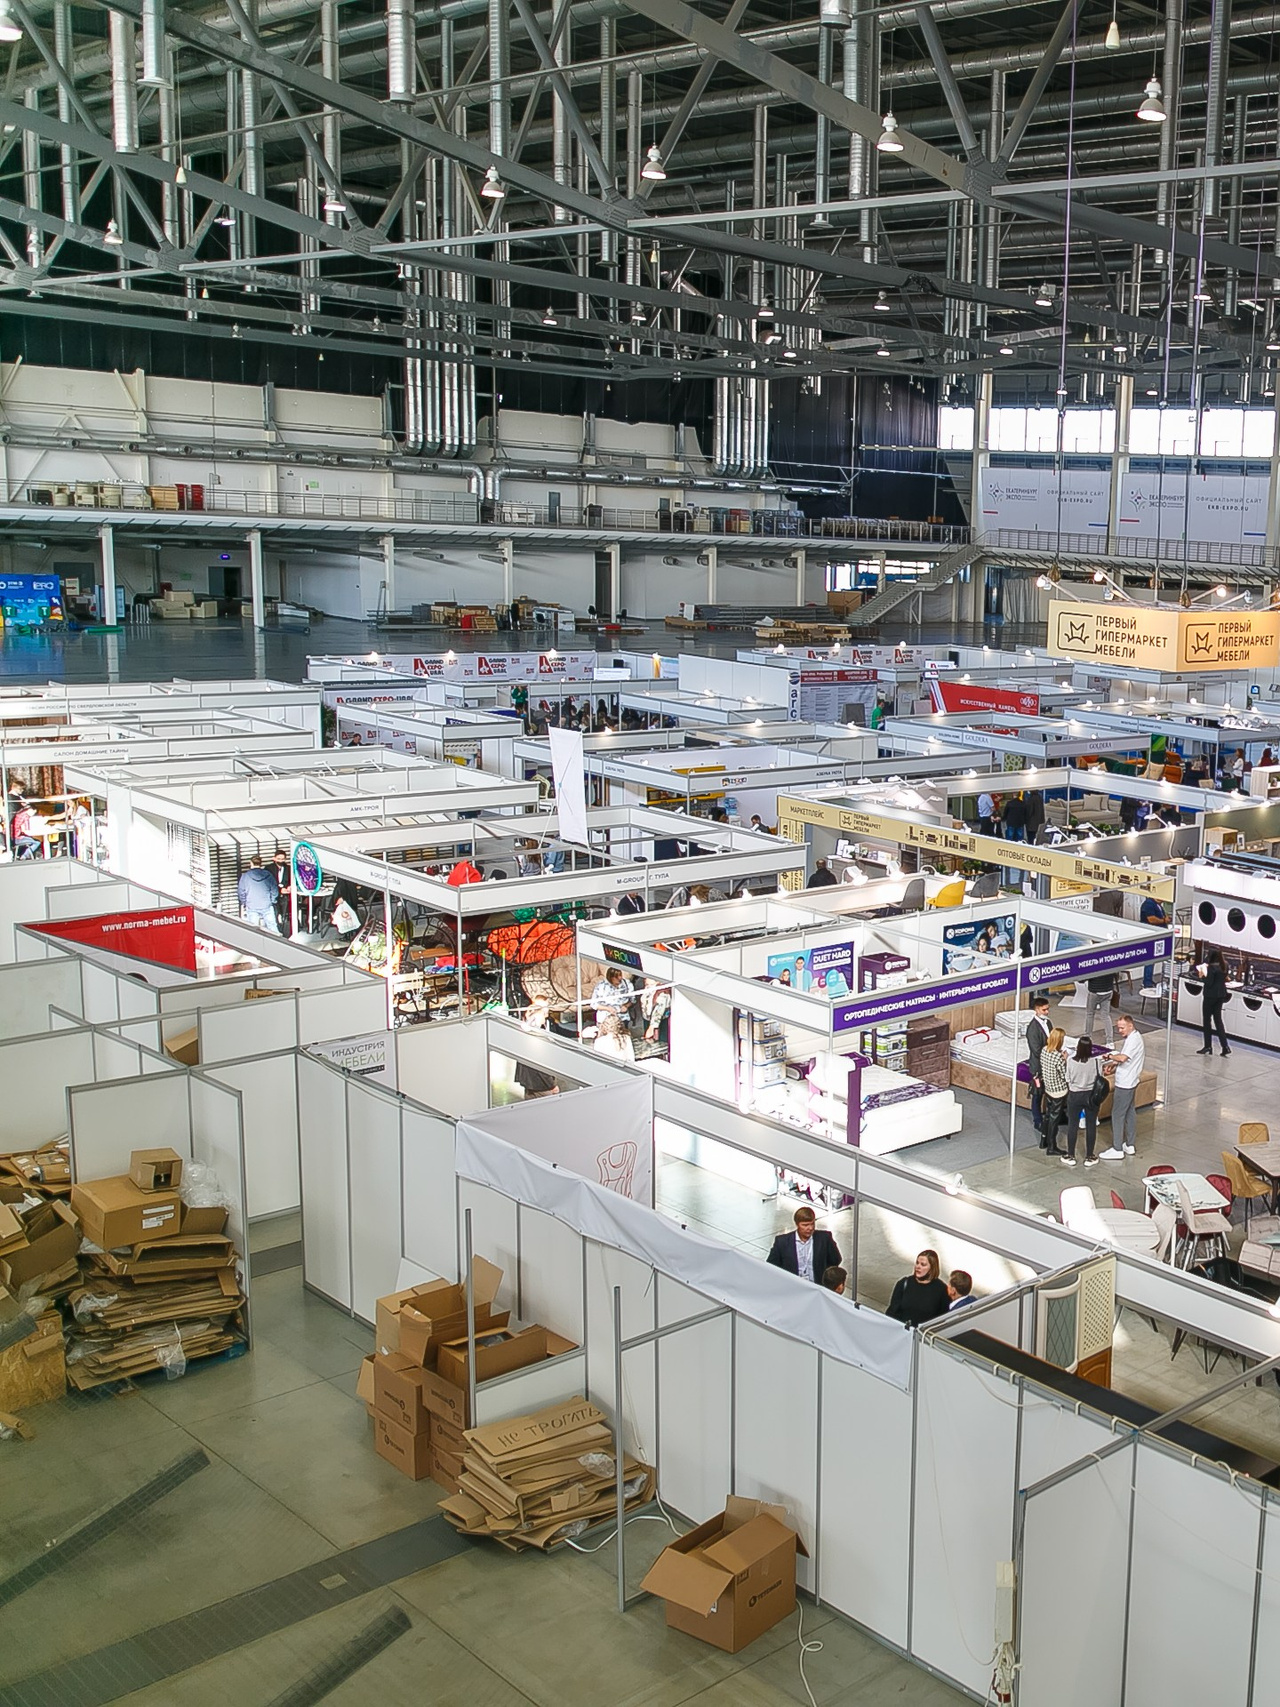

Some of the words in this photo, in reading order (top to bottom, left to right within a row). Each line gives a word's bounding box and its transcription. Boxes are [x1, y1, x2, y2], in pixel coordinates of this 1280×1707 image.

[1095, 615, 1137, 630] ПЕРВЫЙ
[1218, 620, 1251, 634] ПЕРВЫЙ
[1095, 629, 1168, 648] ГИПЕРМАРКЕТ
[1217, 635, 1274, 648] ГИПЕРМАРКЕТ
[1094, 644, 1136, 659] МЕБЕЛИ
[1217, 650, 1250, 662] МЕБЕЛИ
[960, 699, 996, 709] ИСКУССТВЕННЫЙ
[965, 734, 989, 743] GOLDERA
[349, 804, 380, 812] АМК-ТРОЯ
[790, 806, 824, 819] МАРКЕТПЛЕЙС
[997, 848, 1025, 861] ОПТОВЫЕ
[1026, 854, 1052, 867] СКЛАДЫ
[616, 877, 646, 885] M-GROUP
[101, 915, 187, 932] www.norma-mebel.ru
[813, 953, 831, 963] DUET
[832, 950, 851, 960] HARD
[1078, 959, 1099, 968] МЕБЕЛЬ
[1104, 953, 1124, 963] ТОВАРЫ
[1124, 950, 1136, 959] ДЛЯ
[1136, 948, 1147, 956] СНА
[1041, 962, 1071, 975] КОРОНА
[843, 1000, 905, 1021] ОРТОПЕДИЧЕСКИЕ
[905, 995, 936, 1007] МАТРАСЫ
[939, 985, 982, 1000] ИНТЕРЬЕРНЫЕ
[982, 977, 1009, 991] КРОВАТИ
[331, 1041, 385, 1057] ИНДУСТРИЯ
[523, 1406, 601, 1437] ТРОГАТЬ
